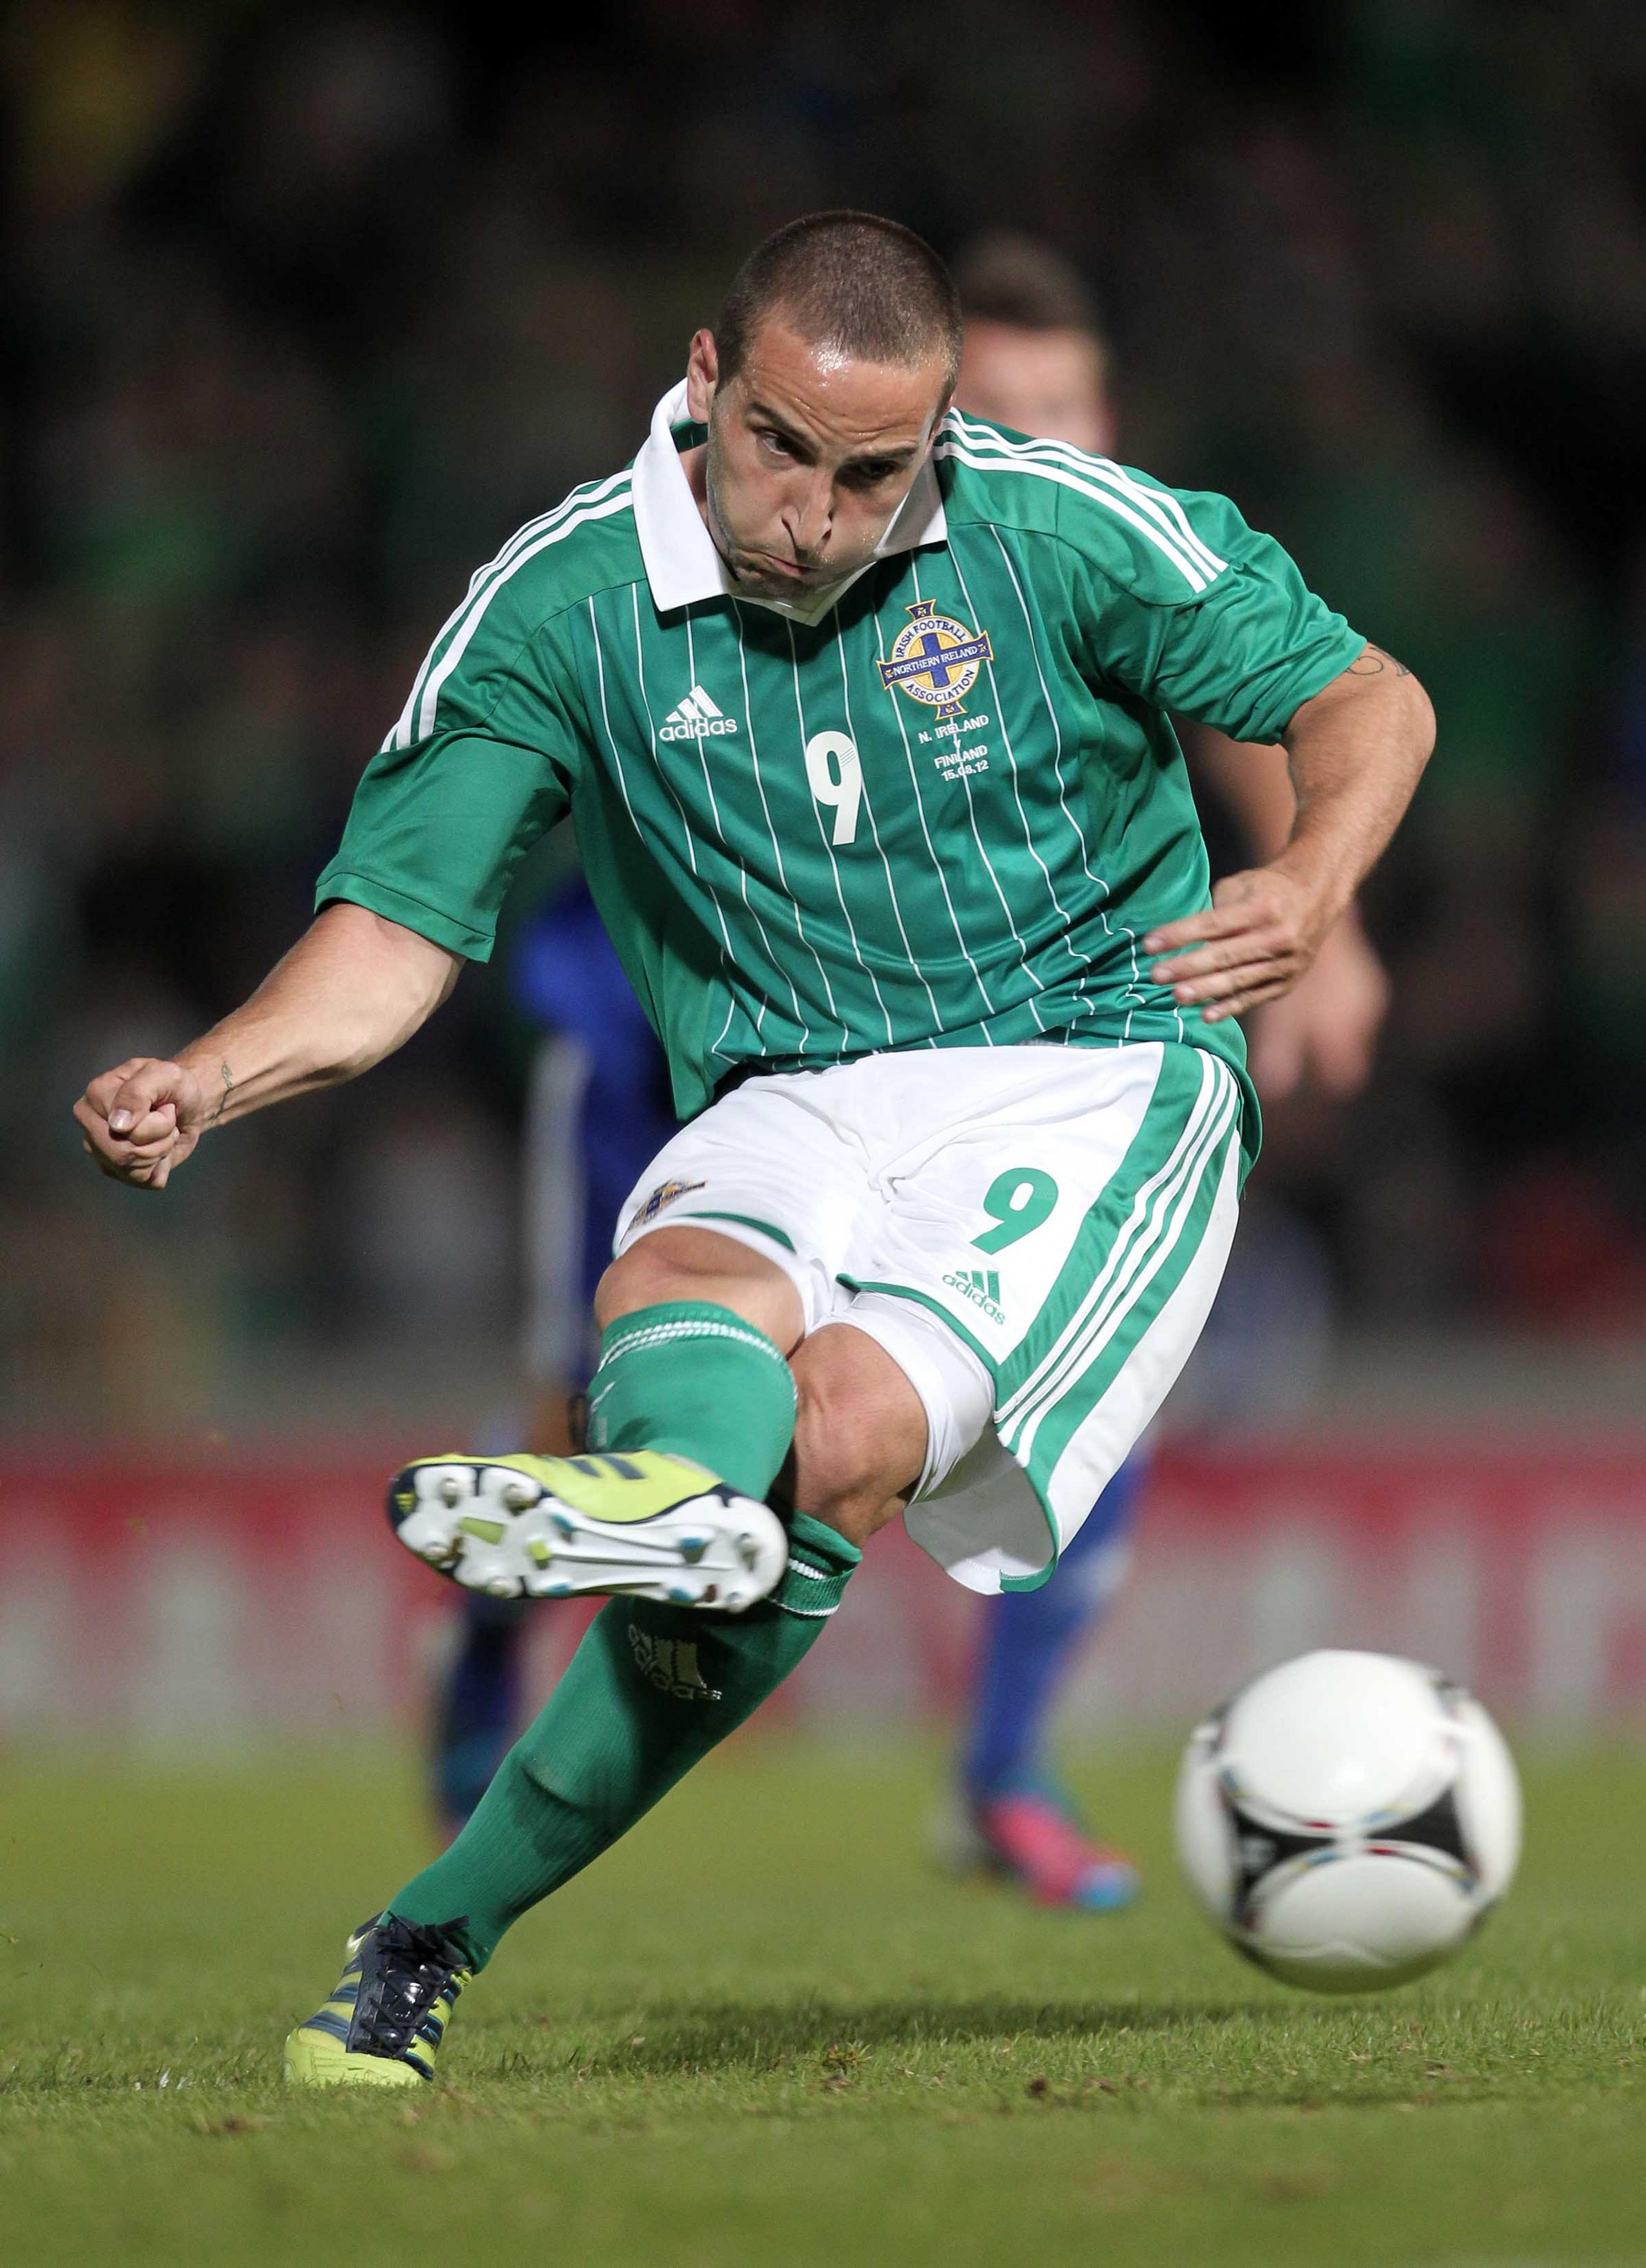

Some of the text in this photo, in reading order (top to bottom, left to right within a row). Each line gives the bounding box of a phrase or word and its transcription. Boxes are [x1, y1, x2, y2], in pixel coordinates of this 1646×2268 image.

[895, 620, 966, 658] IRISH FOOTBALL
[892, 645, 978, 675] NORTHERN IRELAND
[906, 670, 974, 702] ASSOCIATION
[658, 717, 737, 741] adidas
[918, 715, 989, 744] N. IRELAND
[934, 745, 988, 768] FINLAND
[942, 760, 989, 781] 15.08.12
[806, 730, 862, 845] 9
[970, 1167, 1058, 1255] 9
[943, 1275, 1006, 1325] adidas
